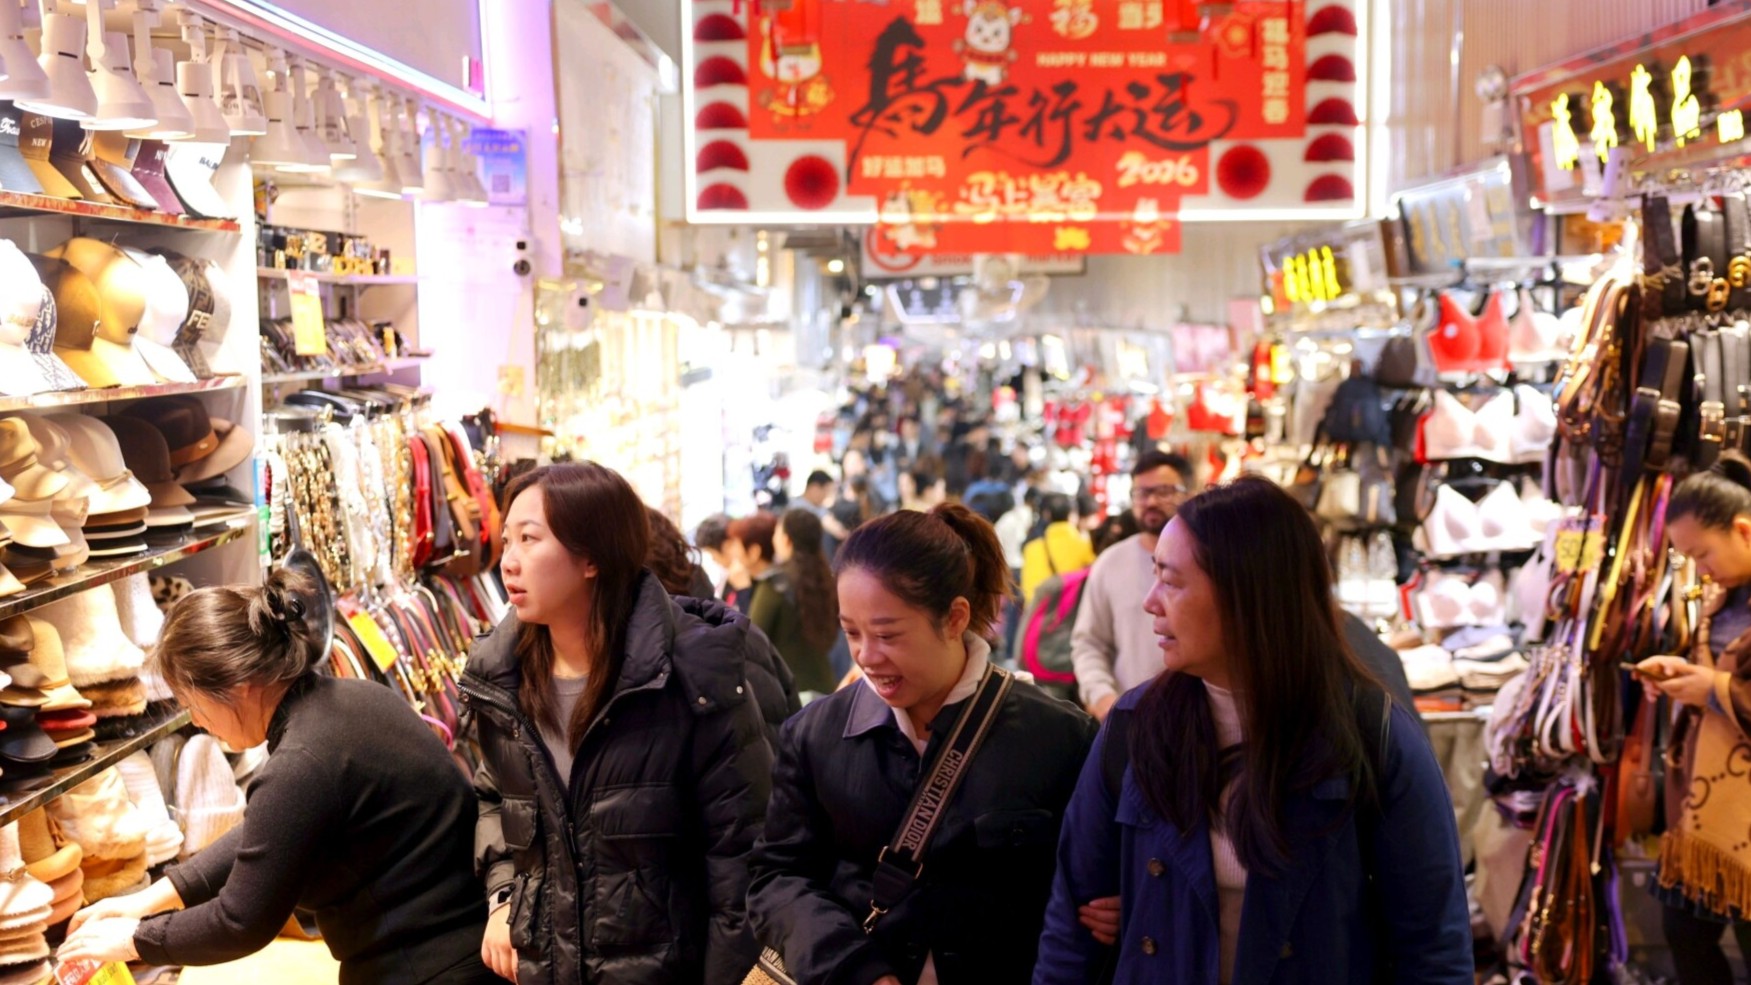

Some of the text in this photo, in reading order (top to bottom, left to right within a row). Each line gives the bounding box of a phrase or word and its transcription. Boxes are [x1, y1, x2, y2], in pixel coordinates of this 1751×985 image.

[1036, 51, 1167, 67] HAPPY NEW YEAR
[902, 749, 963, 850] CHRISTIAN DIOR
